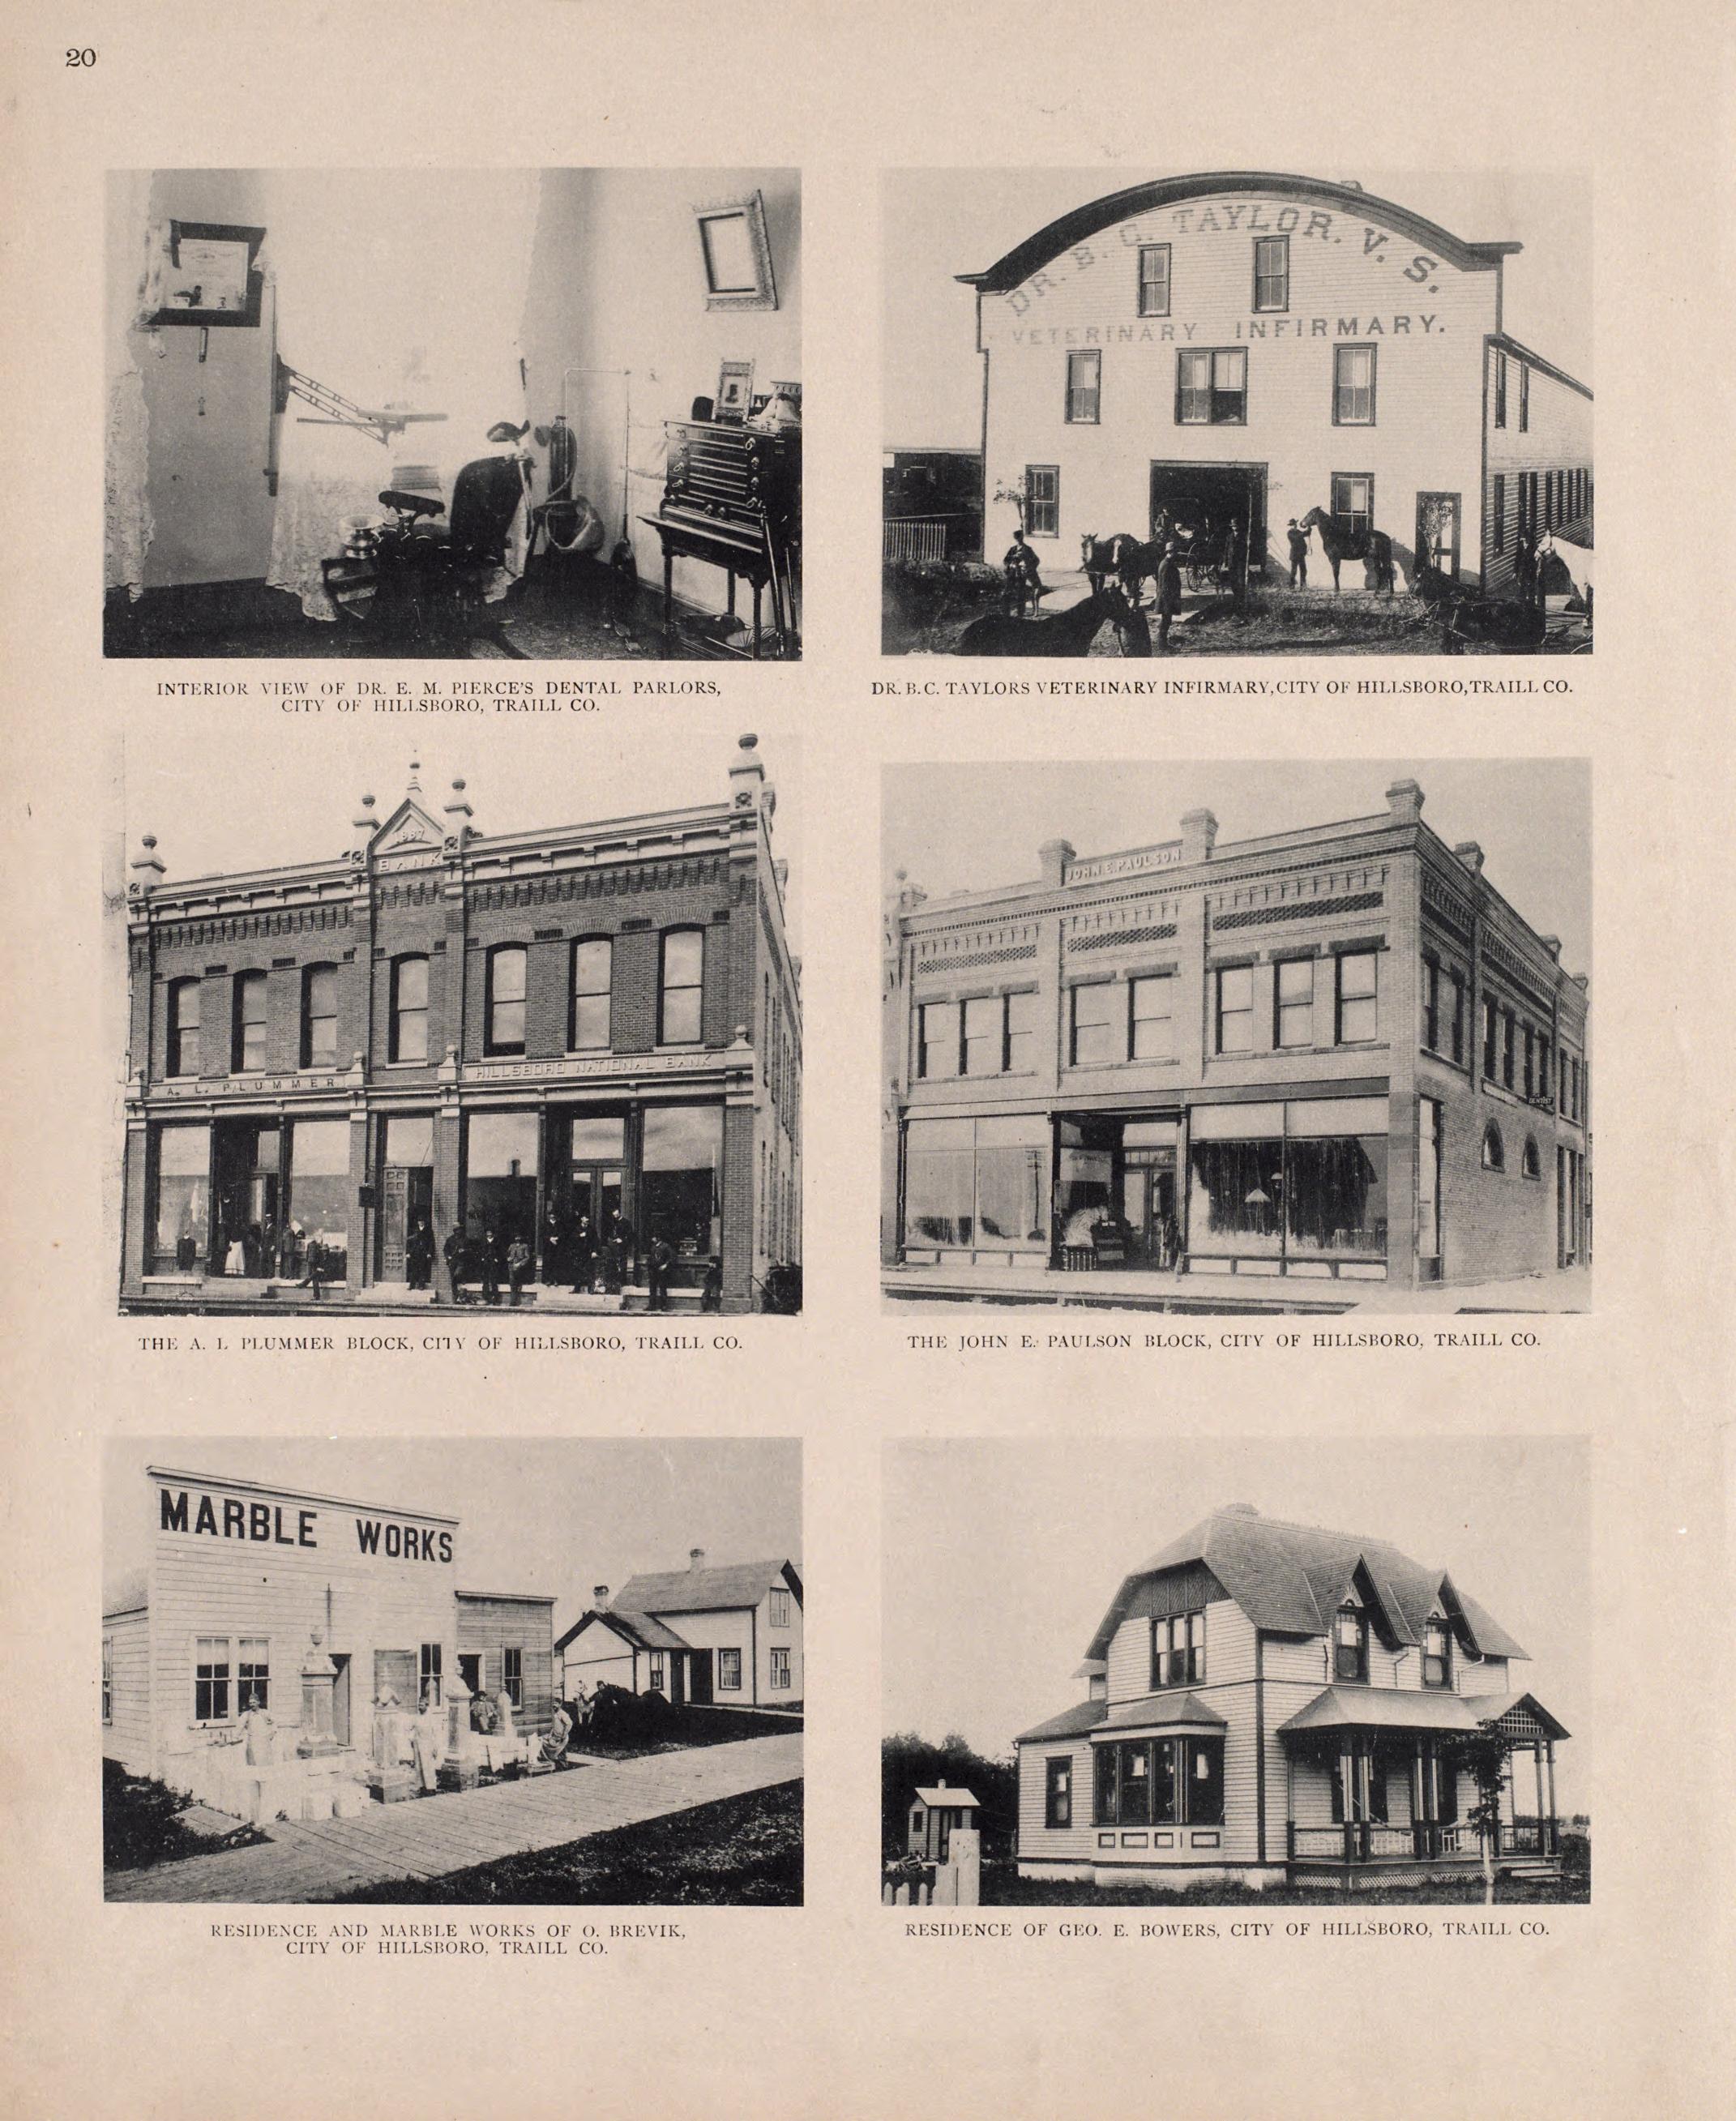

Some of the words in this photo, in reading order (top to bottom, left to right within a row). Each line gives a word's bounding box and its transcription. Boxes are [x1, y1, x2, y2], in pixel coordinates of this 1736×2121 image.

[66, 48, 96, 67] 20
[1362, 228, 1390, 263] V.
[1402, 255, 1439, 293] S.
[1012, 323, 1198, 345] VETERINARY
[1235, 314, 1445, 339] INFIRMARY.
[156, 682, 249, 695] INTERIOR
[261, 682, 309, 695] VIEW
[321, 682, 345, 695] OF
[357, 682, 387, 695] DR.
[396, 682, 412, 695] E.
[423, 682, 442, 695] M.
[452, 681, 533, 695] PIERCE'S
[545, 681, 622, 695] DENTAL
[633, 681, 721, 697] PARLORS,
[871, 682, 901, 695] DR.
[945, 682, 1030, 695] TAYLORS
[1036, 681, 1158, 695] VETERINARY
[1326, 680, 1351, 695] OF
[1542, 679, 1573, 694] CO.
[281, 699, 325, 712] CITY
[337, 699, 361, 712] OF
[372, 699, 484, 714] HILLSBORO,
[493, 699, 562, 712] TRAILL
[570, 698, 601, 712] CO.
[378, 852, 441, 872] BANK
[1068, 864, 1101, 881] JOHN
[1118, 849, 1182, 870] PAULSON
[476, 1062, 566, 1079] HILLSBORO
[576, 1057, 655, 1074] NATIONAL
[665, 1054, 712, 1070] BANK
[167, 1087, 181, 1096] A.
[195, 1084, 209, 1094] L.
[223, 1077, 334, 1093] PLUMMER
[139, 1336, 178, 1350] THE
[189, 1336, 206, 1350] A.
[241, 1336, 335, 1350] PLUMMER
[347, 1336, 414, 1352] BLOCK,
[422, 1336, 466, 1350] CITY
[478, 1336, 502, 1350] OF
[515, 1336, 626, 1352] HILLSBORO,
[635, 1336, 704, 1349] TRAILL
[712, 1336, 743, 1349] CO.
[907, 1336, 947, 1349] THE
[959, 1335, 1007, 1351] JOHN
[1048, 1335, 1131, 1349] PAULSON
[1145, 1334, 1212, 1349] BLOCK,
[1220, 1334, 1264, 1348] CITY
[1276, 1334, 1301, 1347] OF
[1312, 1333, 1424, 1349] HILLSBORO,
[1434, 1333, 1503, 1347] TRAILL
[1511, 1332, 1541, 1346] CO.
[160, 1489, 318, 1548] MARBLE
[356, 1518, 453, 1563] WORKS
[212, 1924, 317, 1938] RESIDENCE
[329, 1924, 368, 1937] AND
[381, 1924, 458, 1937] MARBLE
[469, 1924, 535, 1938] WORKS
[546, 1924, 571, 1938] OF
[582, 1925, 600, 1938] O.
[609, 1924, 686, 1939] BREVIK,
[905, 1923, 1012, 1937] RESIDENCE
[1023, 1923, 1048, 1937] OF
[1058, 1923, 1102, 1937] GEO.
[1113, 1923, 1129, 1937] E.
[1140, 1923, 1221, 1939] BOWERS,
[1230, 1923, 1274, 1937] CITY
[1285, 1922, 1311, 1936] OF
[1323, 1922, 1433, 1938] HILLSBORO,
[1442, 1922, 1512, 1935] TRAILL
[1520, 1922, 1550, 1935] CO.
[286, 1941, 331, 1955] CITY
[342, 1941, 366, 1955] OF
[378, 1941, 489, 1956] HILLSBORO,
[499, 1941, 567, 1955] TRAILL
[579, 1941, 609, 1955] CO.
